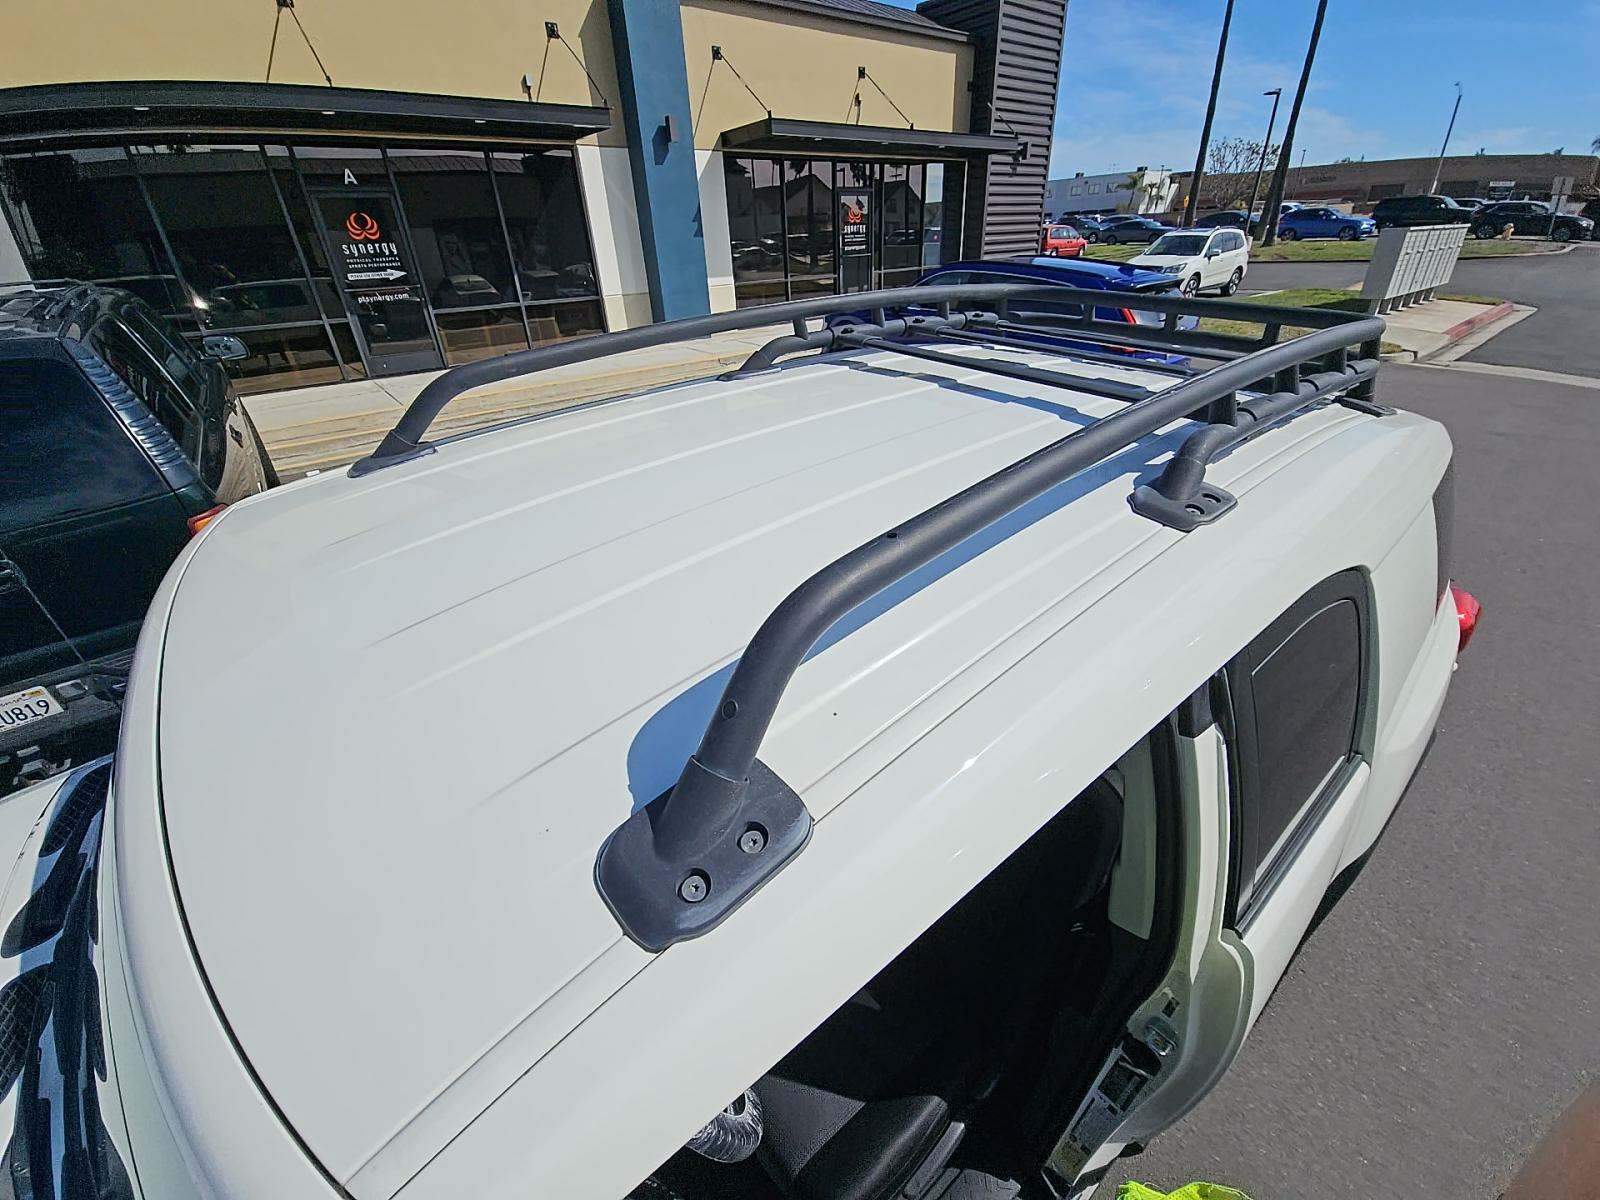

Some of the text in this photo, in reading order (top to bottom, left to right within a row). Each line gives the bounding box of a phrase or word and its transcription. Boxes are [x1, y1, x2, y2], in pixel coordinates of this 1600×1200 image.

[344, 168, 358, 185] A
[341, 242, 398, 257] synergy
[357, 293, 410, 304] ptsynergy.com
[0, 699, 50, 728] U819
